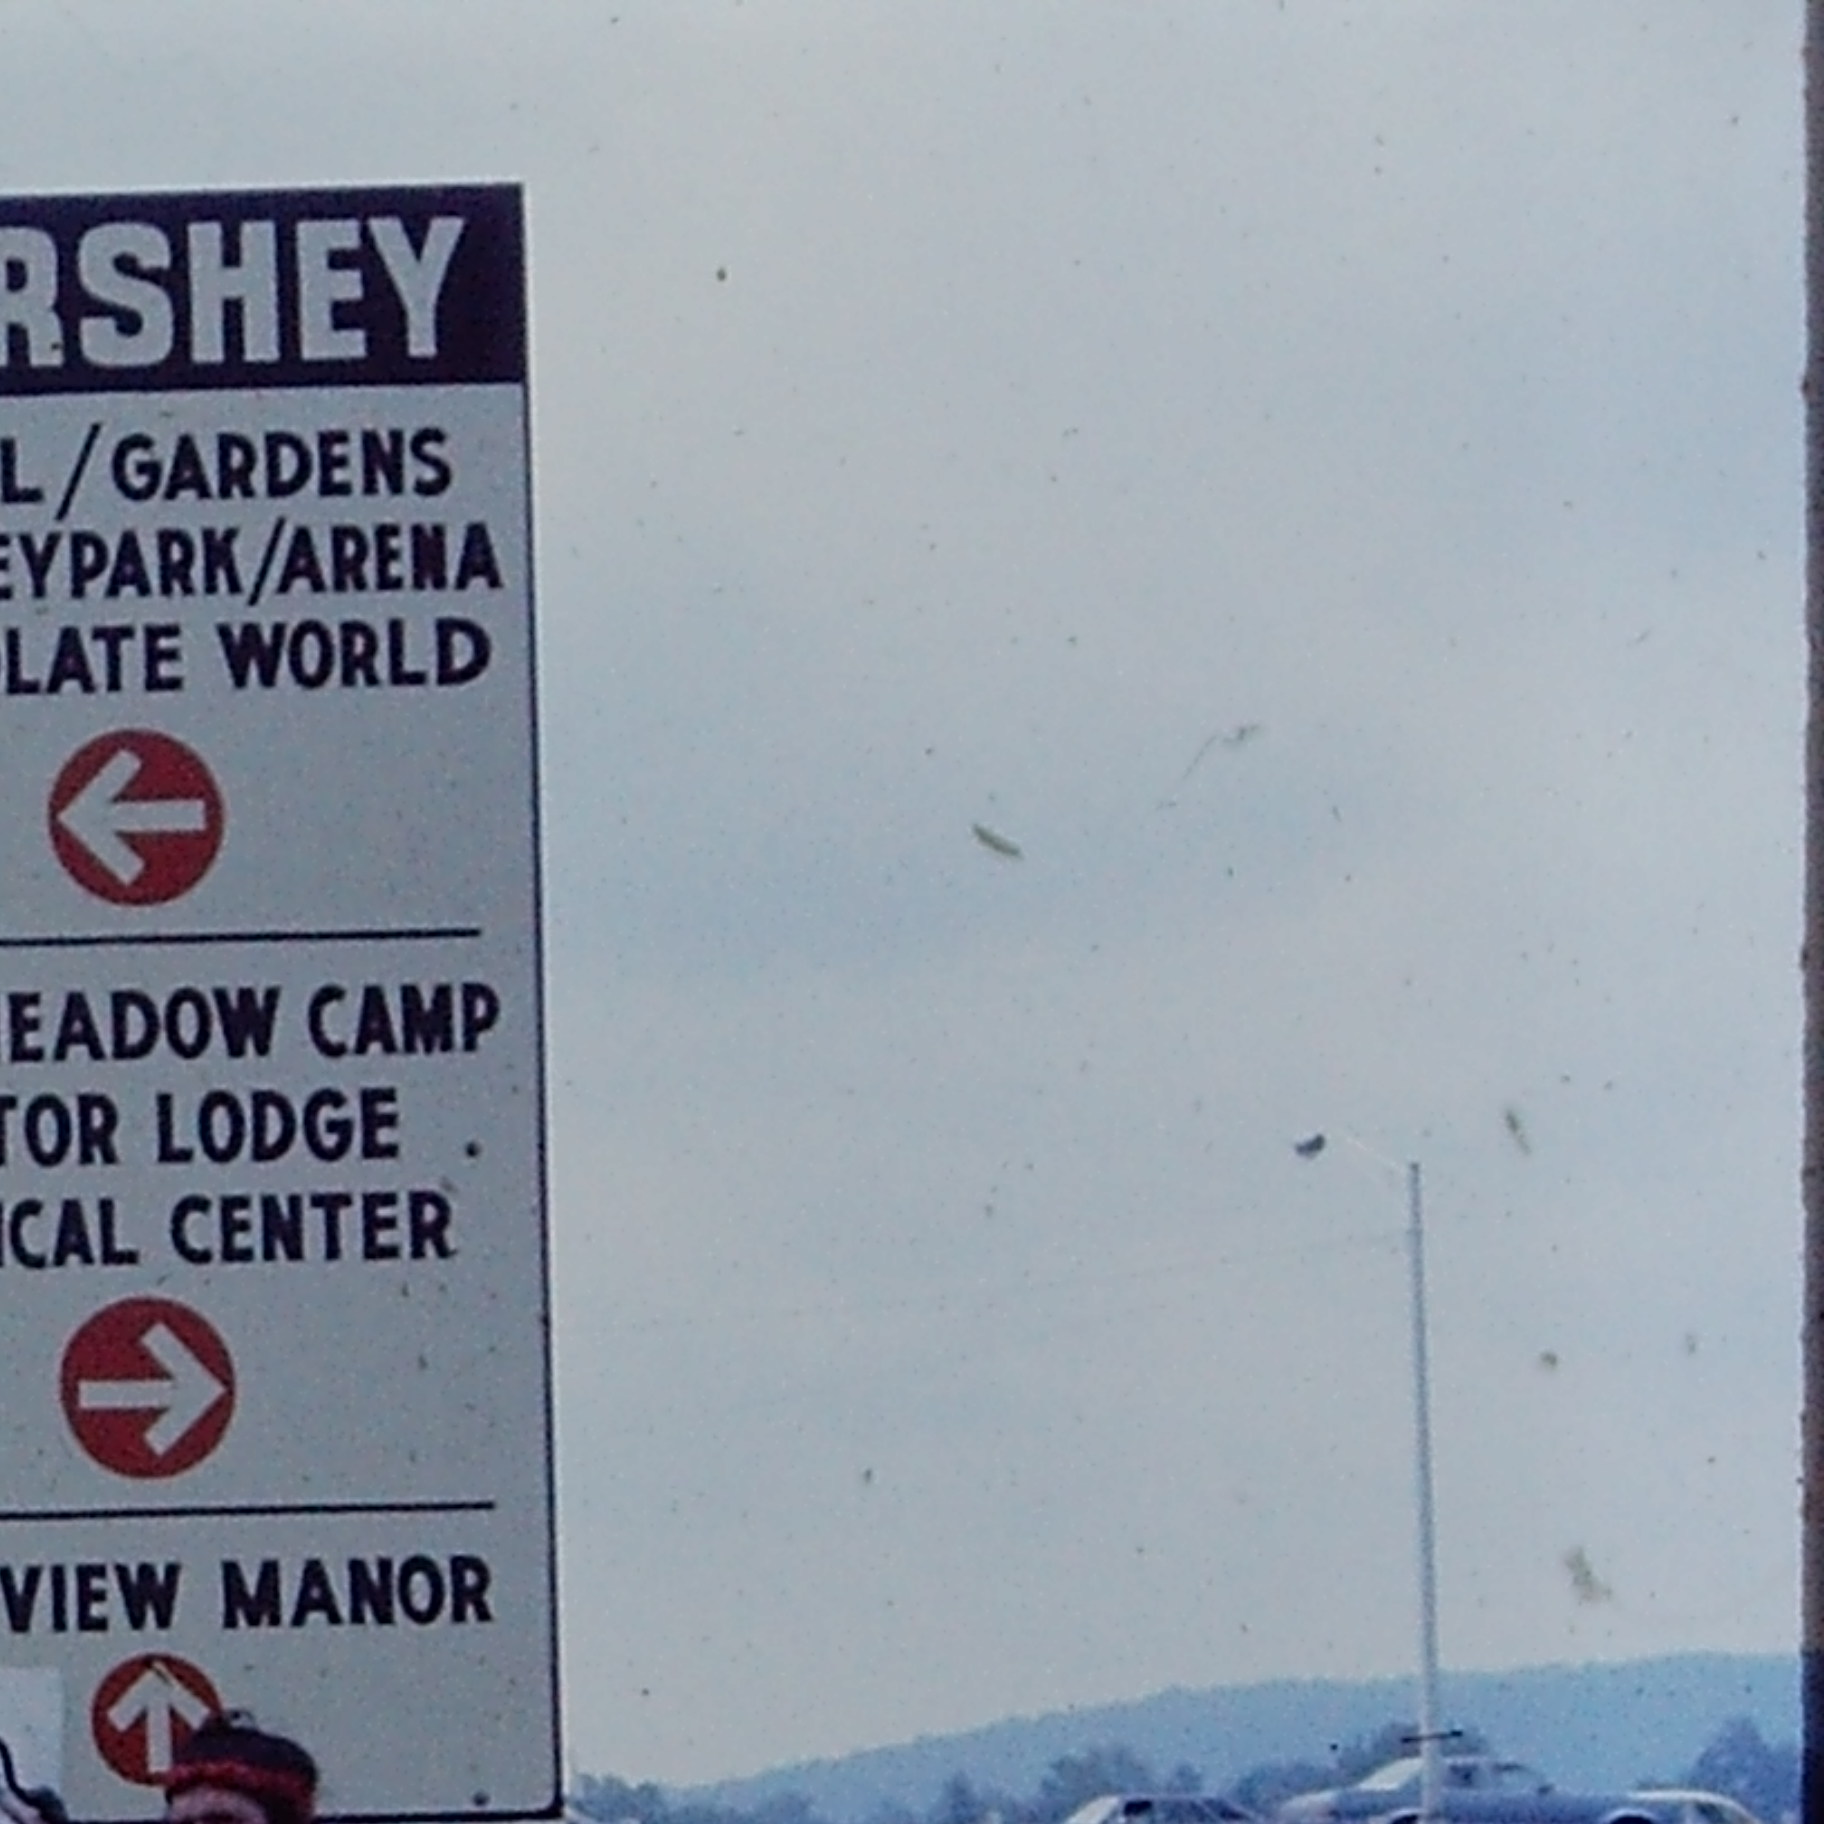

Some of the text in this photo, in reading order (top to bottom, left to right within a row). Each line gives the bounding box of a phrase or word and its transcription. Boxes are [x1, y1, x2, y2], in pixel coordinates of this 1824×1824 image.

[217, 618, 490, 689] WORLD
[308, 983, 499, 1058] CAMP
[157, 1088, 399, 1164] LODGE
[171, 1191, 455, 1265] CENTER
[222, 1555, 492, 1629] MANOR
